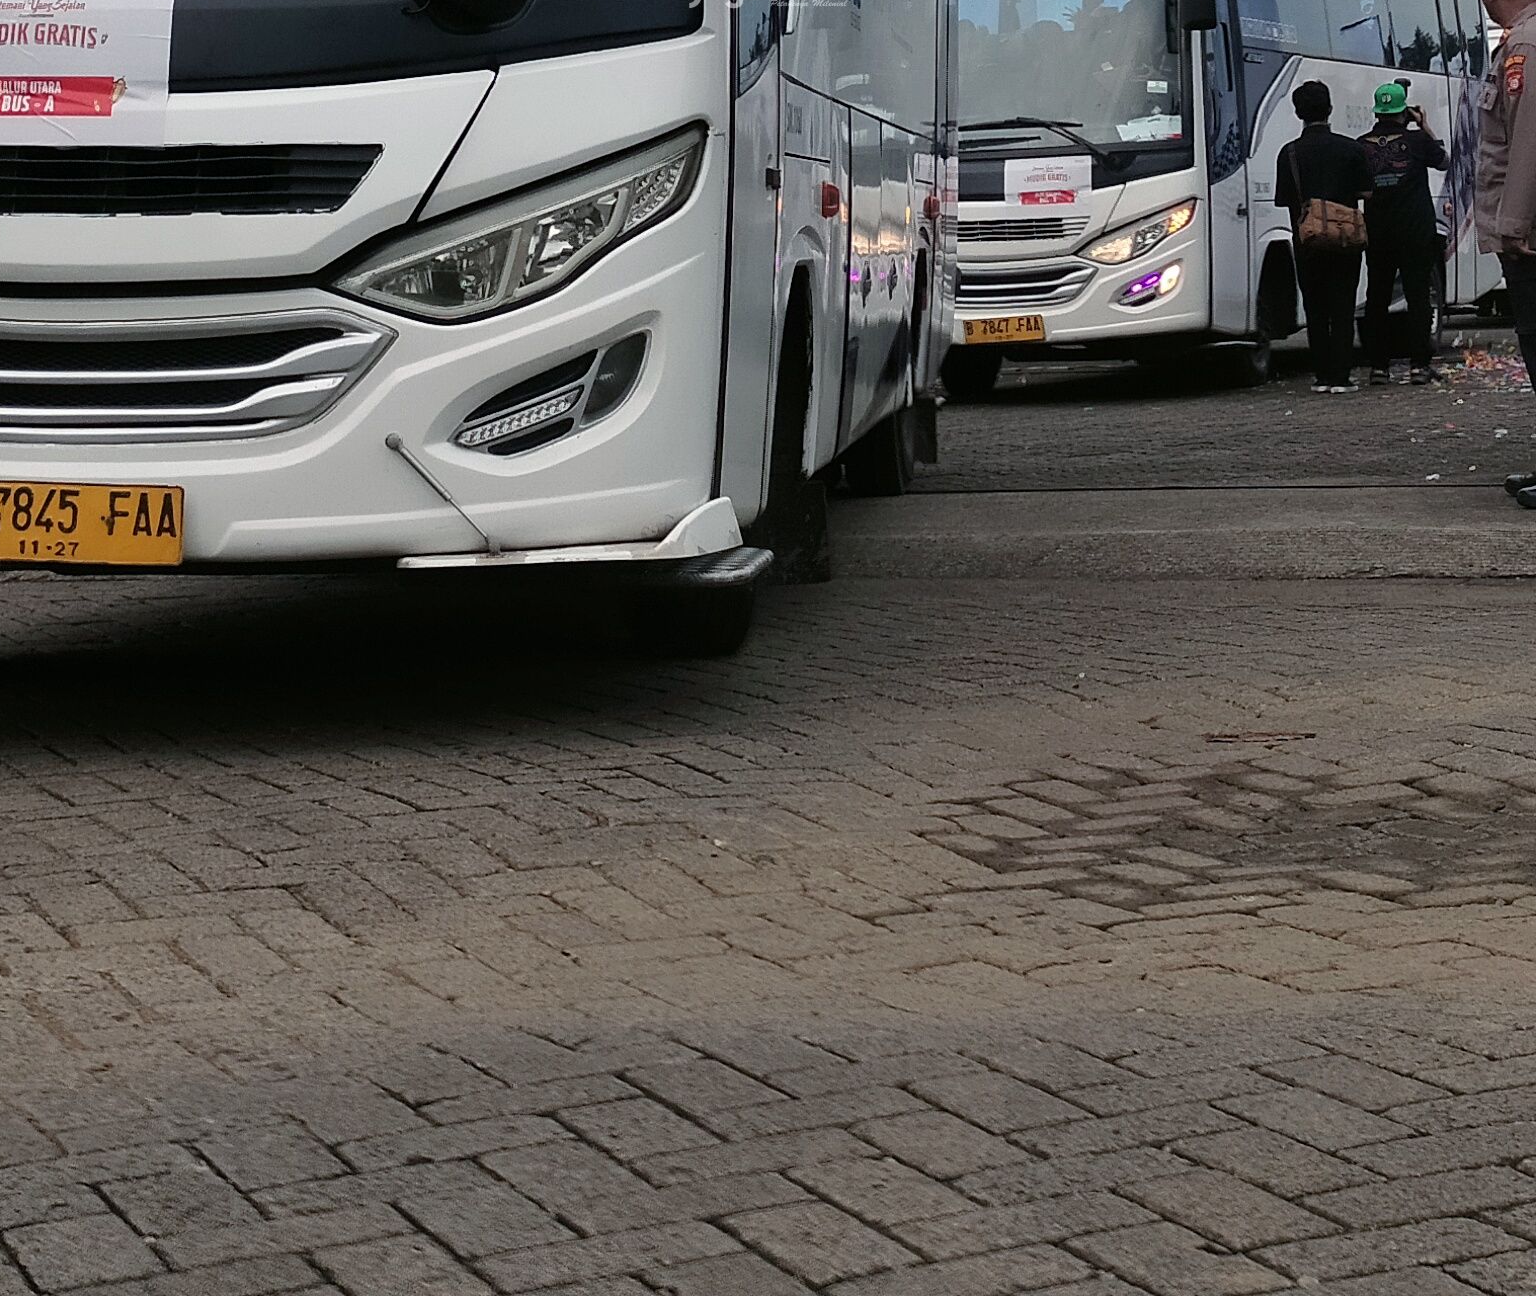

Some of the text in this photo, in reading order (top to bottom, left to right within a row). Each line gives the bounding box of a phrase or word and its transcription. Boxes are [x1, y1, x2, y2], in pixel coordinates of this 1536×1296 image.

[34, 23, 98, 49] GRATIS
[29, 80, 62, 94] UTARA
[1, 95, 31, 112] BUS
[44, 95, 54, 112] A
[1018, 316, 1041, 332] FAA
[107, 490, 177, 538] FAA
